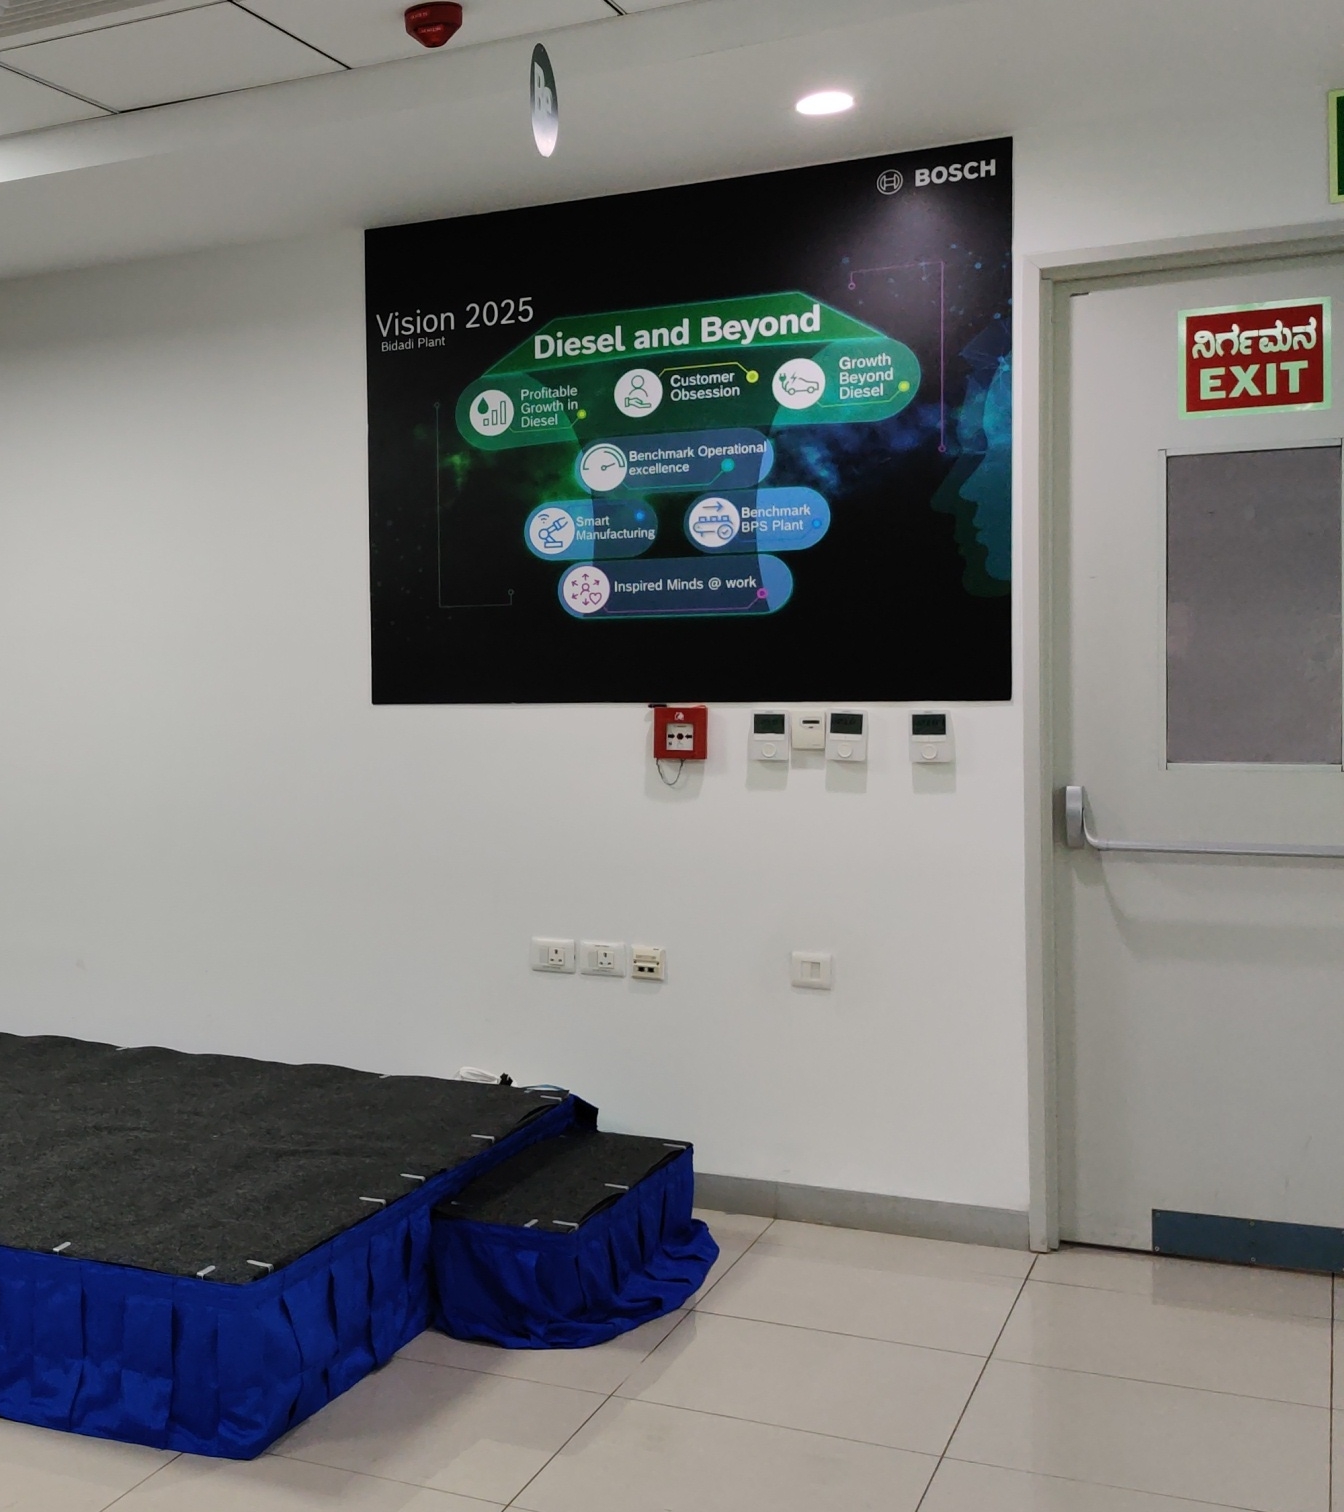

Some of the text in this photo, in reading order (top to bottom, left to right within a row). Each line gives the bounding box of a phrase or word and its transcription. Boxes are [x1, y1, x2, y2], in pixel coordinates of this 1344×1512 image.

[914, 158, 996, 188] BOSCH
[375, 296, 534, 338] Vision 2025
[534, 303, 822, 360] Diesel and Beyond
[1191, 316, 1318, 360] ನಿರ್ಗಮನ
[381, 335, 446, 352] Bidadi Plant
[838, 352, 892, 370] Growth
[670, 372, 736, 388] Customer
[839, 366, 894, 386] Beyond
[1199, 359, 1310, 401] EXIT
[520, 384, 578, 401] Profitable
[670, 384, 741, 402] Obsession
[839, 382, 884, 400] Diesel
[520, 398, 578, 415] Growth in
[521, 413, 559, 428] Diesel
[628, 439, 768, 462] Benchmark Operational
[628, 462, 690, 476] excellence
[741, 503, 811, 519] Benchmark
[576, 515, 610, 527] Smart
[741, 518, 804, 533] BPS Plant
[576, 527, 656, 541] Manufacturing
[614, 575, 757, 594] Inspired Minds @ work
